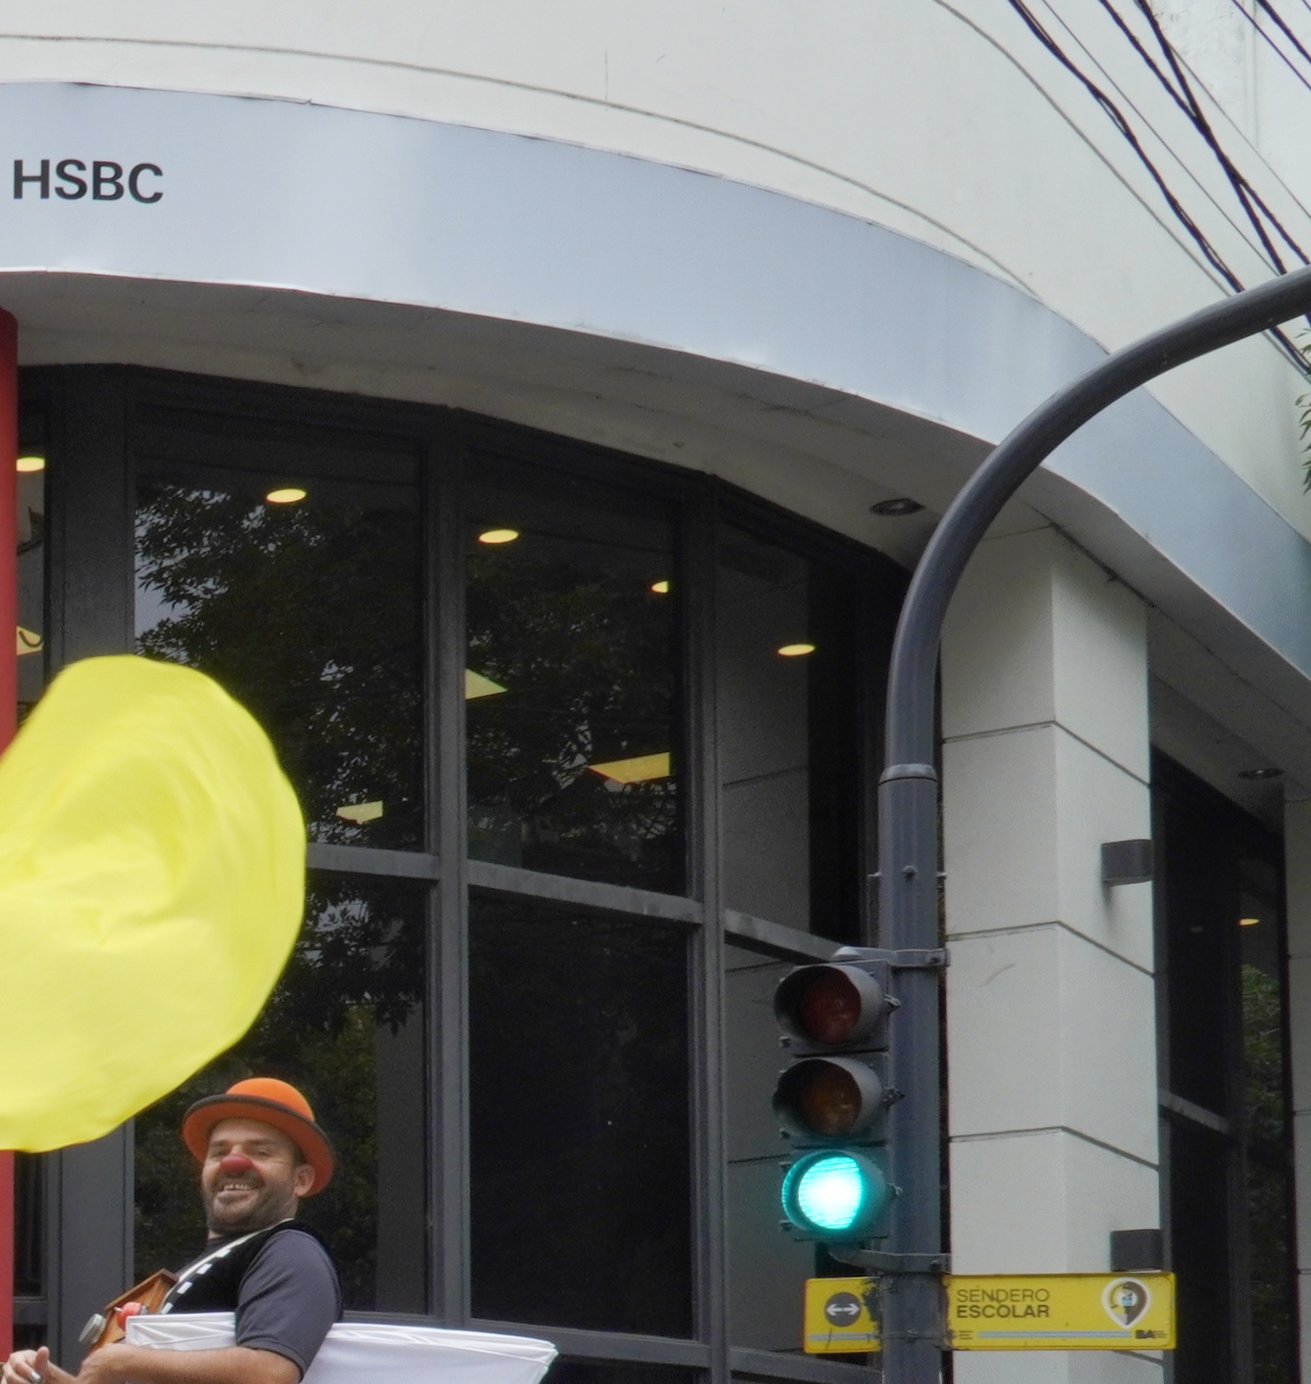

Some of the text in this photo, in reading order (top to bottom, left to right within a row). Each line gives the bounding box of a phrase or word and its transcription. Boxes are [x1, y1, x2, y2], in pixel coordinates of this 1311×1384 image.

[13, 159, 164, 204] HSBC
[956, 1288, 1050, 1303] SENDERO
[956, 1304, 1050, 1318] ESCOLAR
